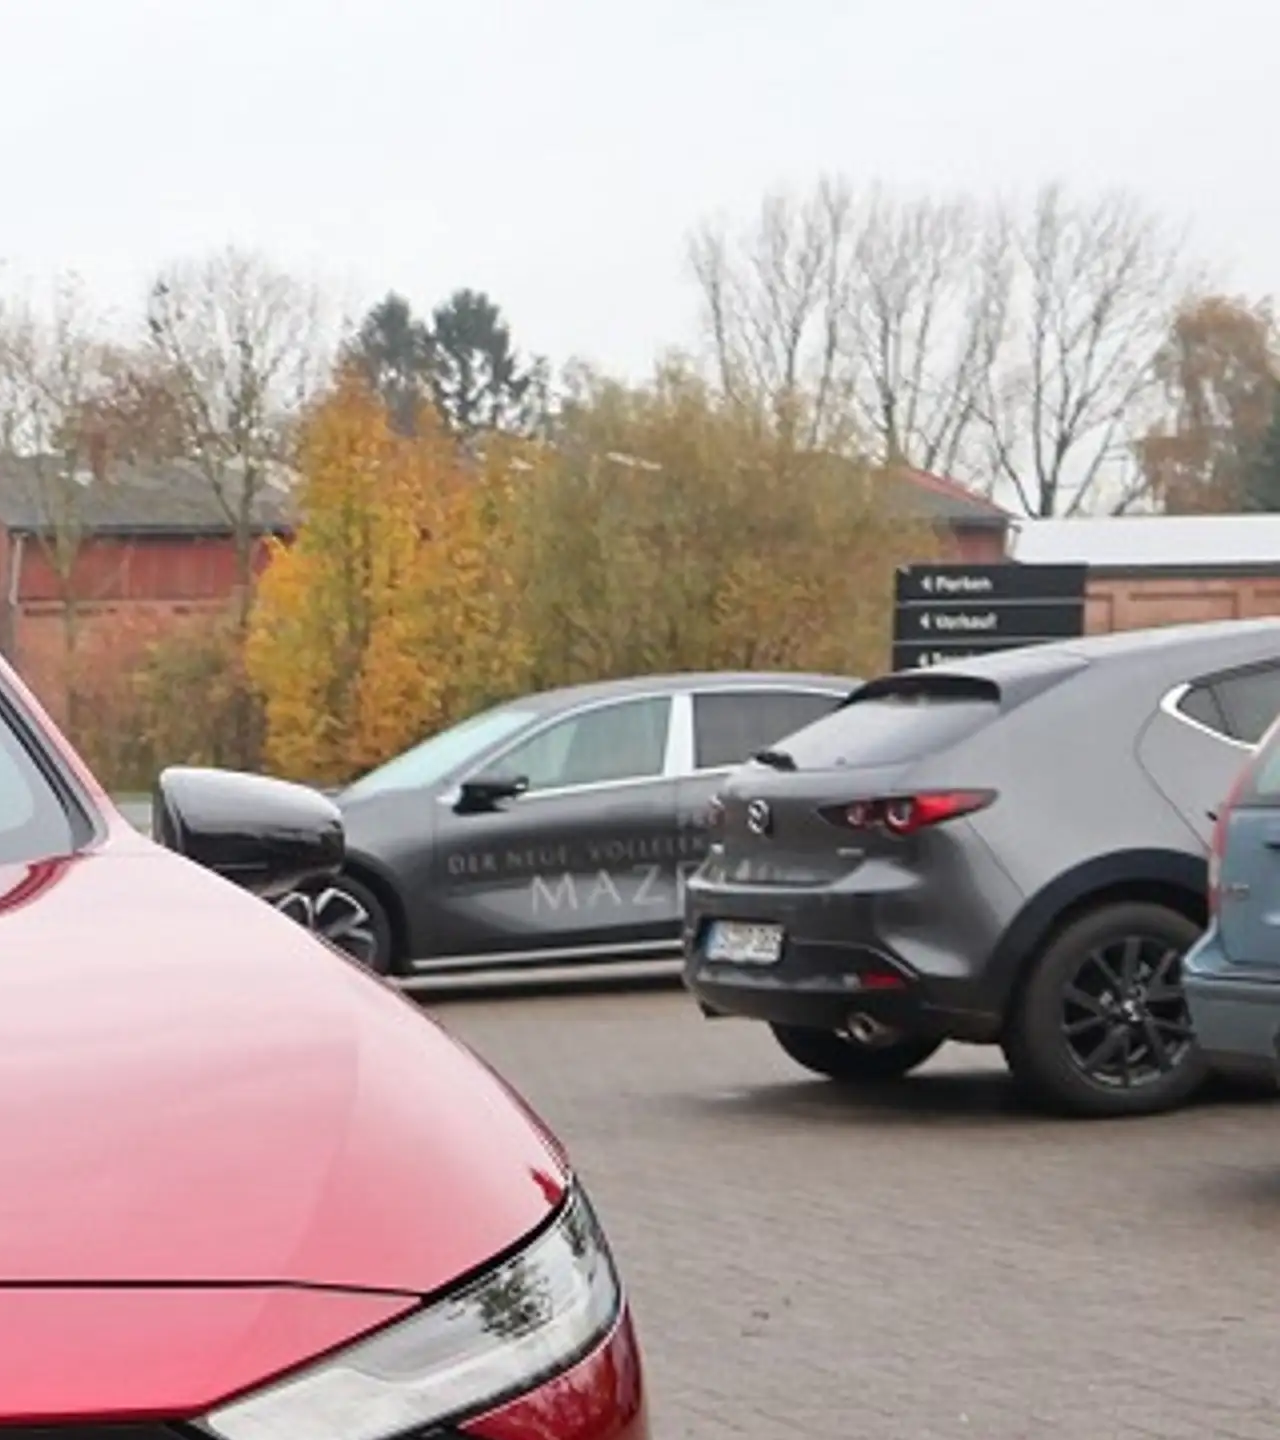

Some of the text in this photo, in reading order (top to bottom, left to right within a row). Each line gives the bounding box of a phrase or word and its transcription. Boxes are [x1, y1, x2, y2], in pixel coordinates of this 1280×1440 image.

[936, 575, 993, 592] Parken
[934, 612, 998, 630] Verkauf
[448, 853, 497, 874] DER
